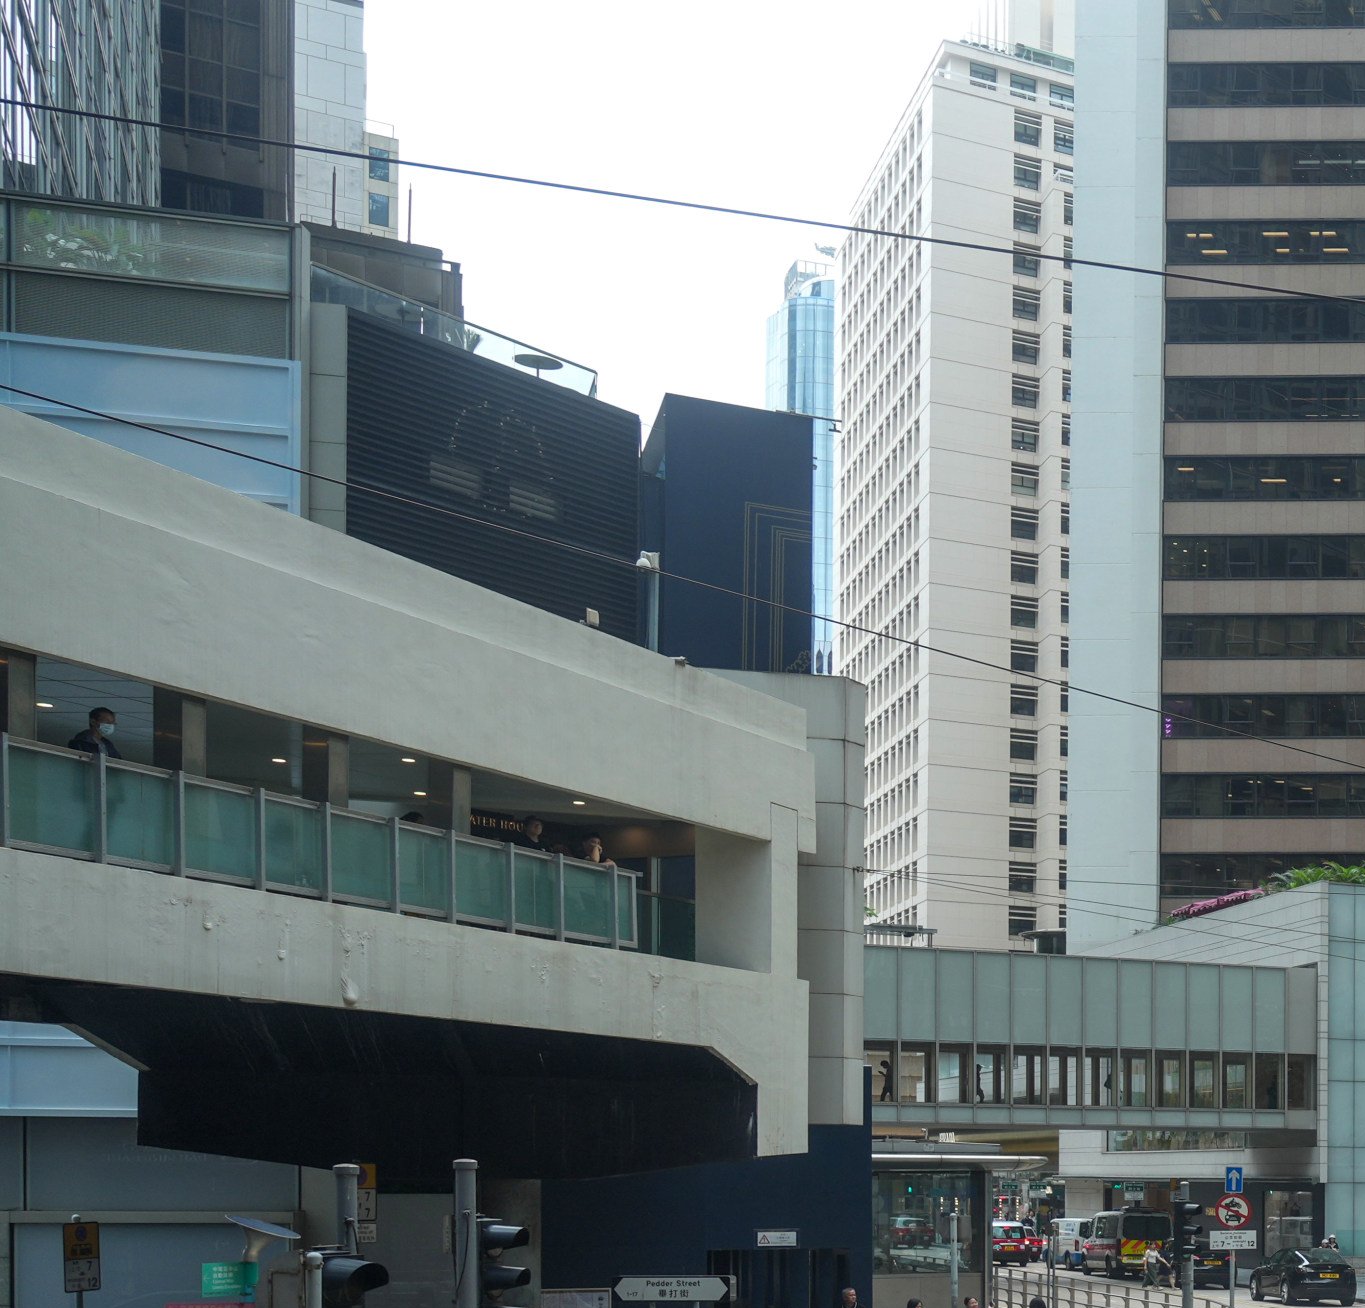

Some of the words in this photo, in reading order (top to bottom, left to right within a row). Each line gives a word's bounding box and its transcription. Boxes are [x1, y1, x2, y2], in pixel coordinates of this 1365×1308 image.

[365, 1191, 371, 1202] 7
[88, 1277, 98, 1288] 12
[646, 1280, 673, 1288] Pedder
[676, 1280, 701, 1288] Street
[658, 1289, 689, 1299] 畢打街
